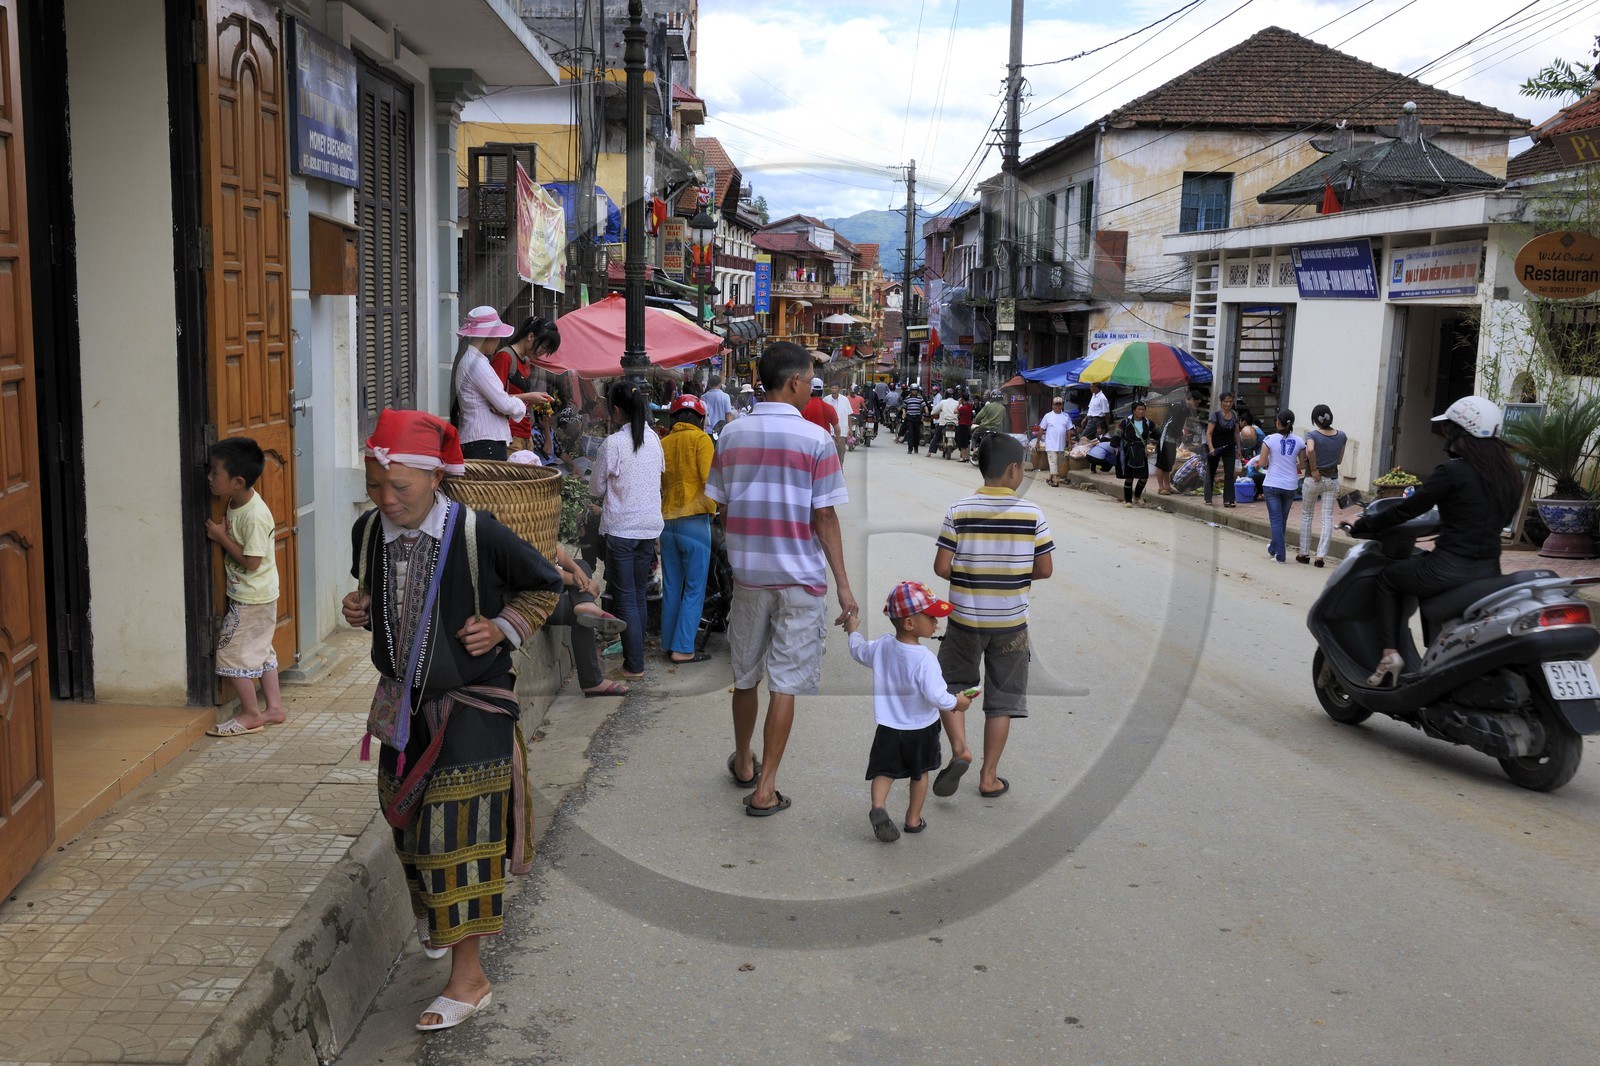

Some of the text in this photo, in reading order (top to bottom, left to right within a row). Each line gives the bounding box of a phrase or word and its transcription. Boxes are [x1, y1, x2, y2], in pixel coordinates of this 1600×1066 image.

[309, 129, 326, 155] MONEY
[1569, 134, 1600, 161] Pi
[1539, 251, 1594, 262] Wild Orchid
[1524, 264, 1600, 282] Restauran
[757, 264, 769, 307] HOTEL
[1280, 439, 1296, 455] 17
[1556, 680, 1593, 696] 5513
